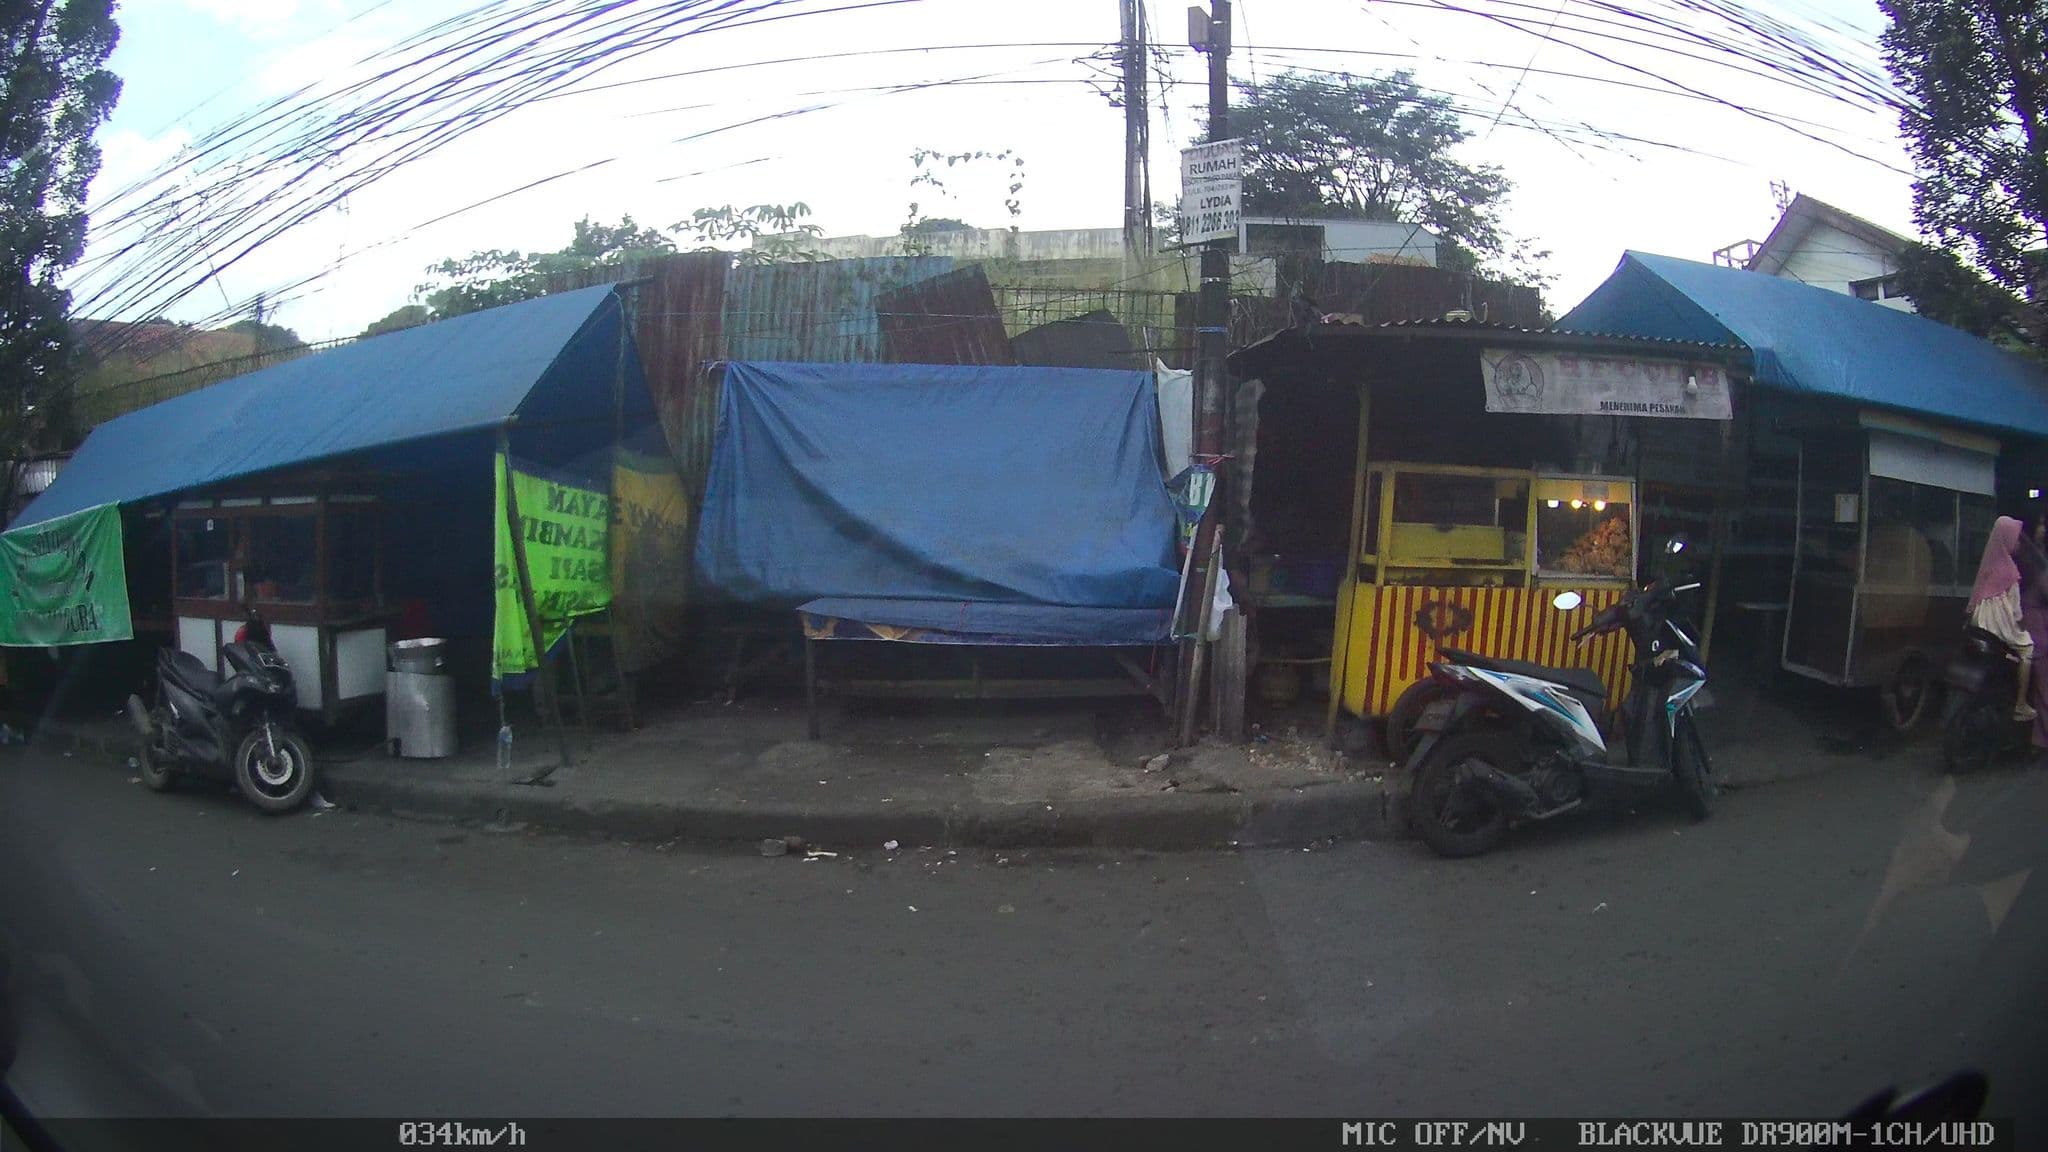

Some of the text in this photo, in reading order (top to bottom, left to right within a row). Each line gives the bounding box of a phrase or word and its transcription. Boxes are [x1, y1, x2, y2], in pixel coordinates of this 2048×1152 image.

[1189, 157, 1237, 175] RUMAH
[1200, 195, 1232, 209] LYDIA
[1599, 400, 1648, 413] MENERIMA
